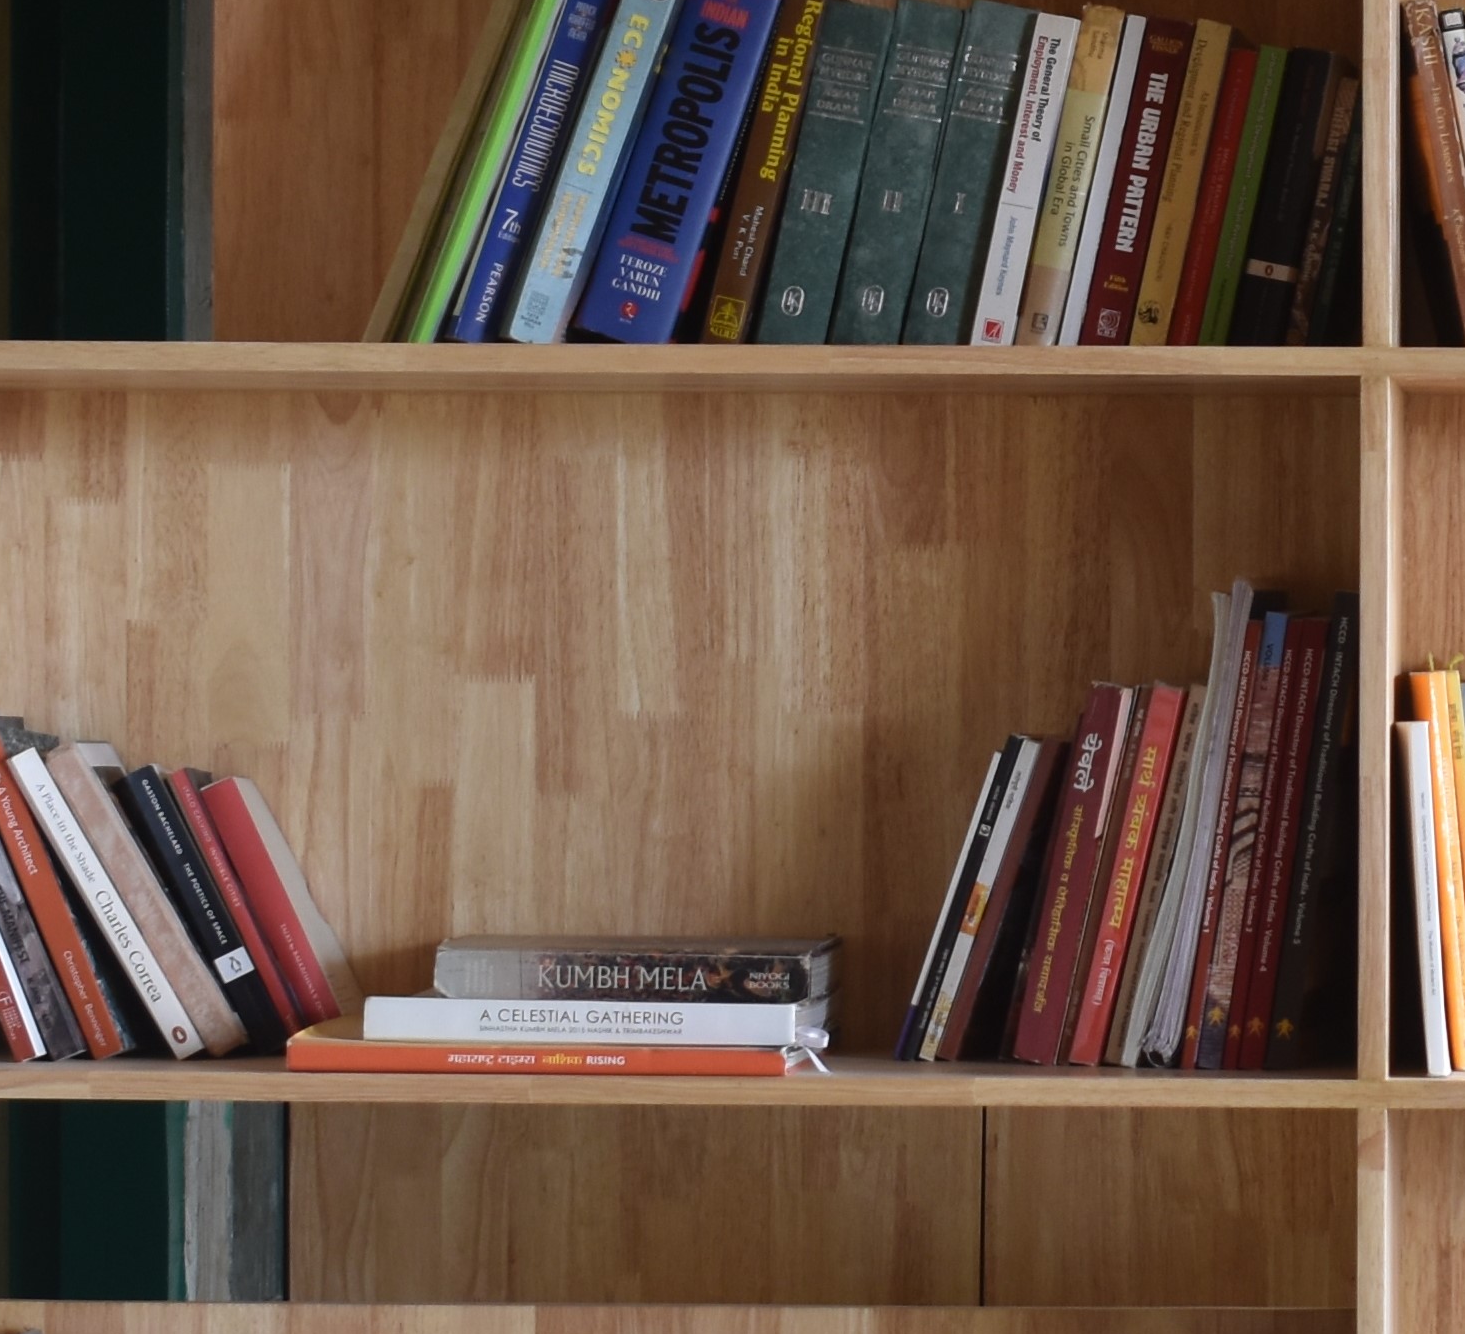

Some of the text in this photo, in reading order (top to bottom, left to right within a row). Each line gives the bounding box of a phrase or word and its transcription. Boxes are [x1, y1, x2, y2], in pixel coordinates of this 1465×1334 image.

[702, 0, 750, 29] INDIAN
[1414, 7, 1437, 66] KASHI
[760, 36, 793, 114] in India
[1031, 36, 1061, 142] The General Theory of
[511, 58, 581, 193] MICROECONOMICS
[632, 18, 741, 245] METROPOLIS
[1006, 35, 1049, 193] Employment, Interest and Money
[759, 90, 799, 182] Planning
[1050, 141, 1075, 216] in Global Era
[1057, 115, 1095, 248] Small Cities and Towns
[1114, 70, 1168, 252] THE URBAN PATTERN
[502, 208, 521, 234] 7th
[739, 205, 764, 276] Mahesh Chand
[620, 254, 667, 277] FEROZE
[621, 267, 659, 287] VARUN
[475, 261, 504, 323] PEARSON
[612, 278, 660, 301] GANDHI
[1336, 616, 1347, 643] HCCD
[1330, 651, 1342, 687] INTACH
[1322, 688, 1337, 729] Directory
[1322, 731, 1331, 741] of
[1072, 730, 1103, 793] येवले
[1137, 744, 1161, 787] सार्थ
[1315, 744, 1329, 791] Traditional
[1307, 793, 1322, 831] Building
[12, 827, 39, 875] Architect
[141, 778, 227, 945] GASTON BACHELARD THE POETICS OF SPACE
[1303, 861, 1311, 870] of
[1305, 832, 1316, 859] Crafts
[1106, 854, 1135, 928] माहात्म्य
[1300, 873, 1310, 894] India
[0, 909, 29, 964] MANIFEST
[1294, 902, 1305, 936] Volume
[93, 887, 164, 1003] Charles Correa
[539, 965, 707, 991] KUMBH MELA
[749, 971, 790, 981] NIYOGI
[749, 981, 790, 990] BOOKS
[480, 1009, 684, 1025] A CELESTIAL GATHERING
[586, 1056, 625, 1065] RISING
